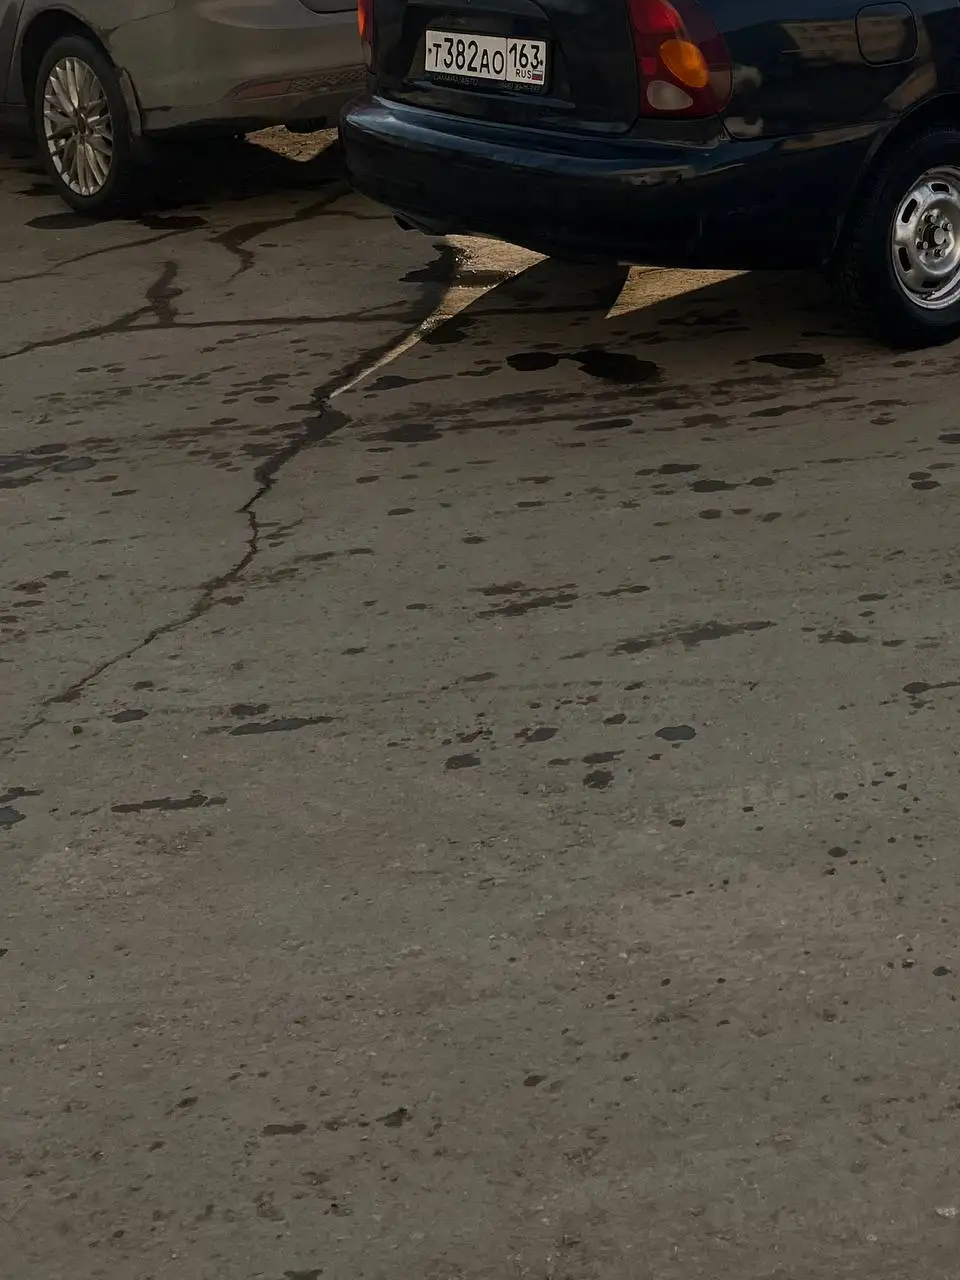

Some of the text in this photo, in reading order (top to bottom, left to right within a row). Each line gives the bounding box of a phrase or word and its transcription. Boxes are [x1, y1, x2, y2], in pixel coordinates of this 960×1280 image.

[433, 37, 540, 75] Т382АО 163
[515, 68, 532, 80] RUS
